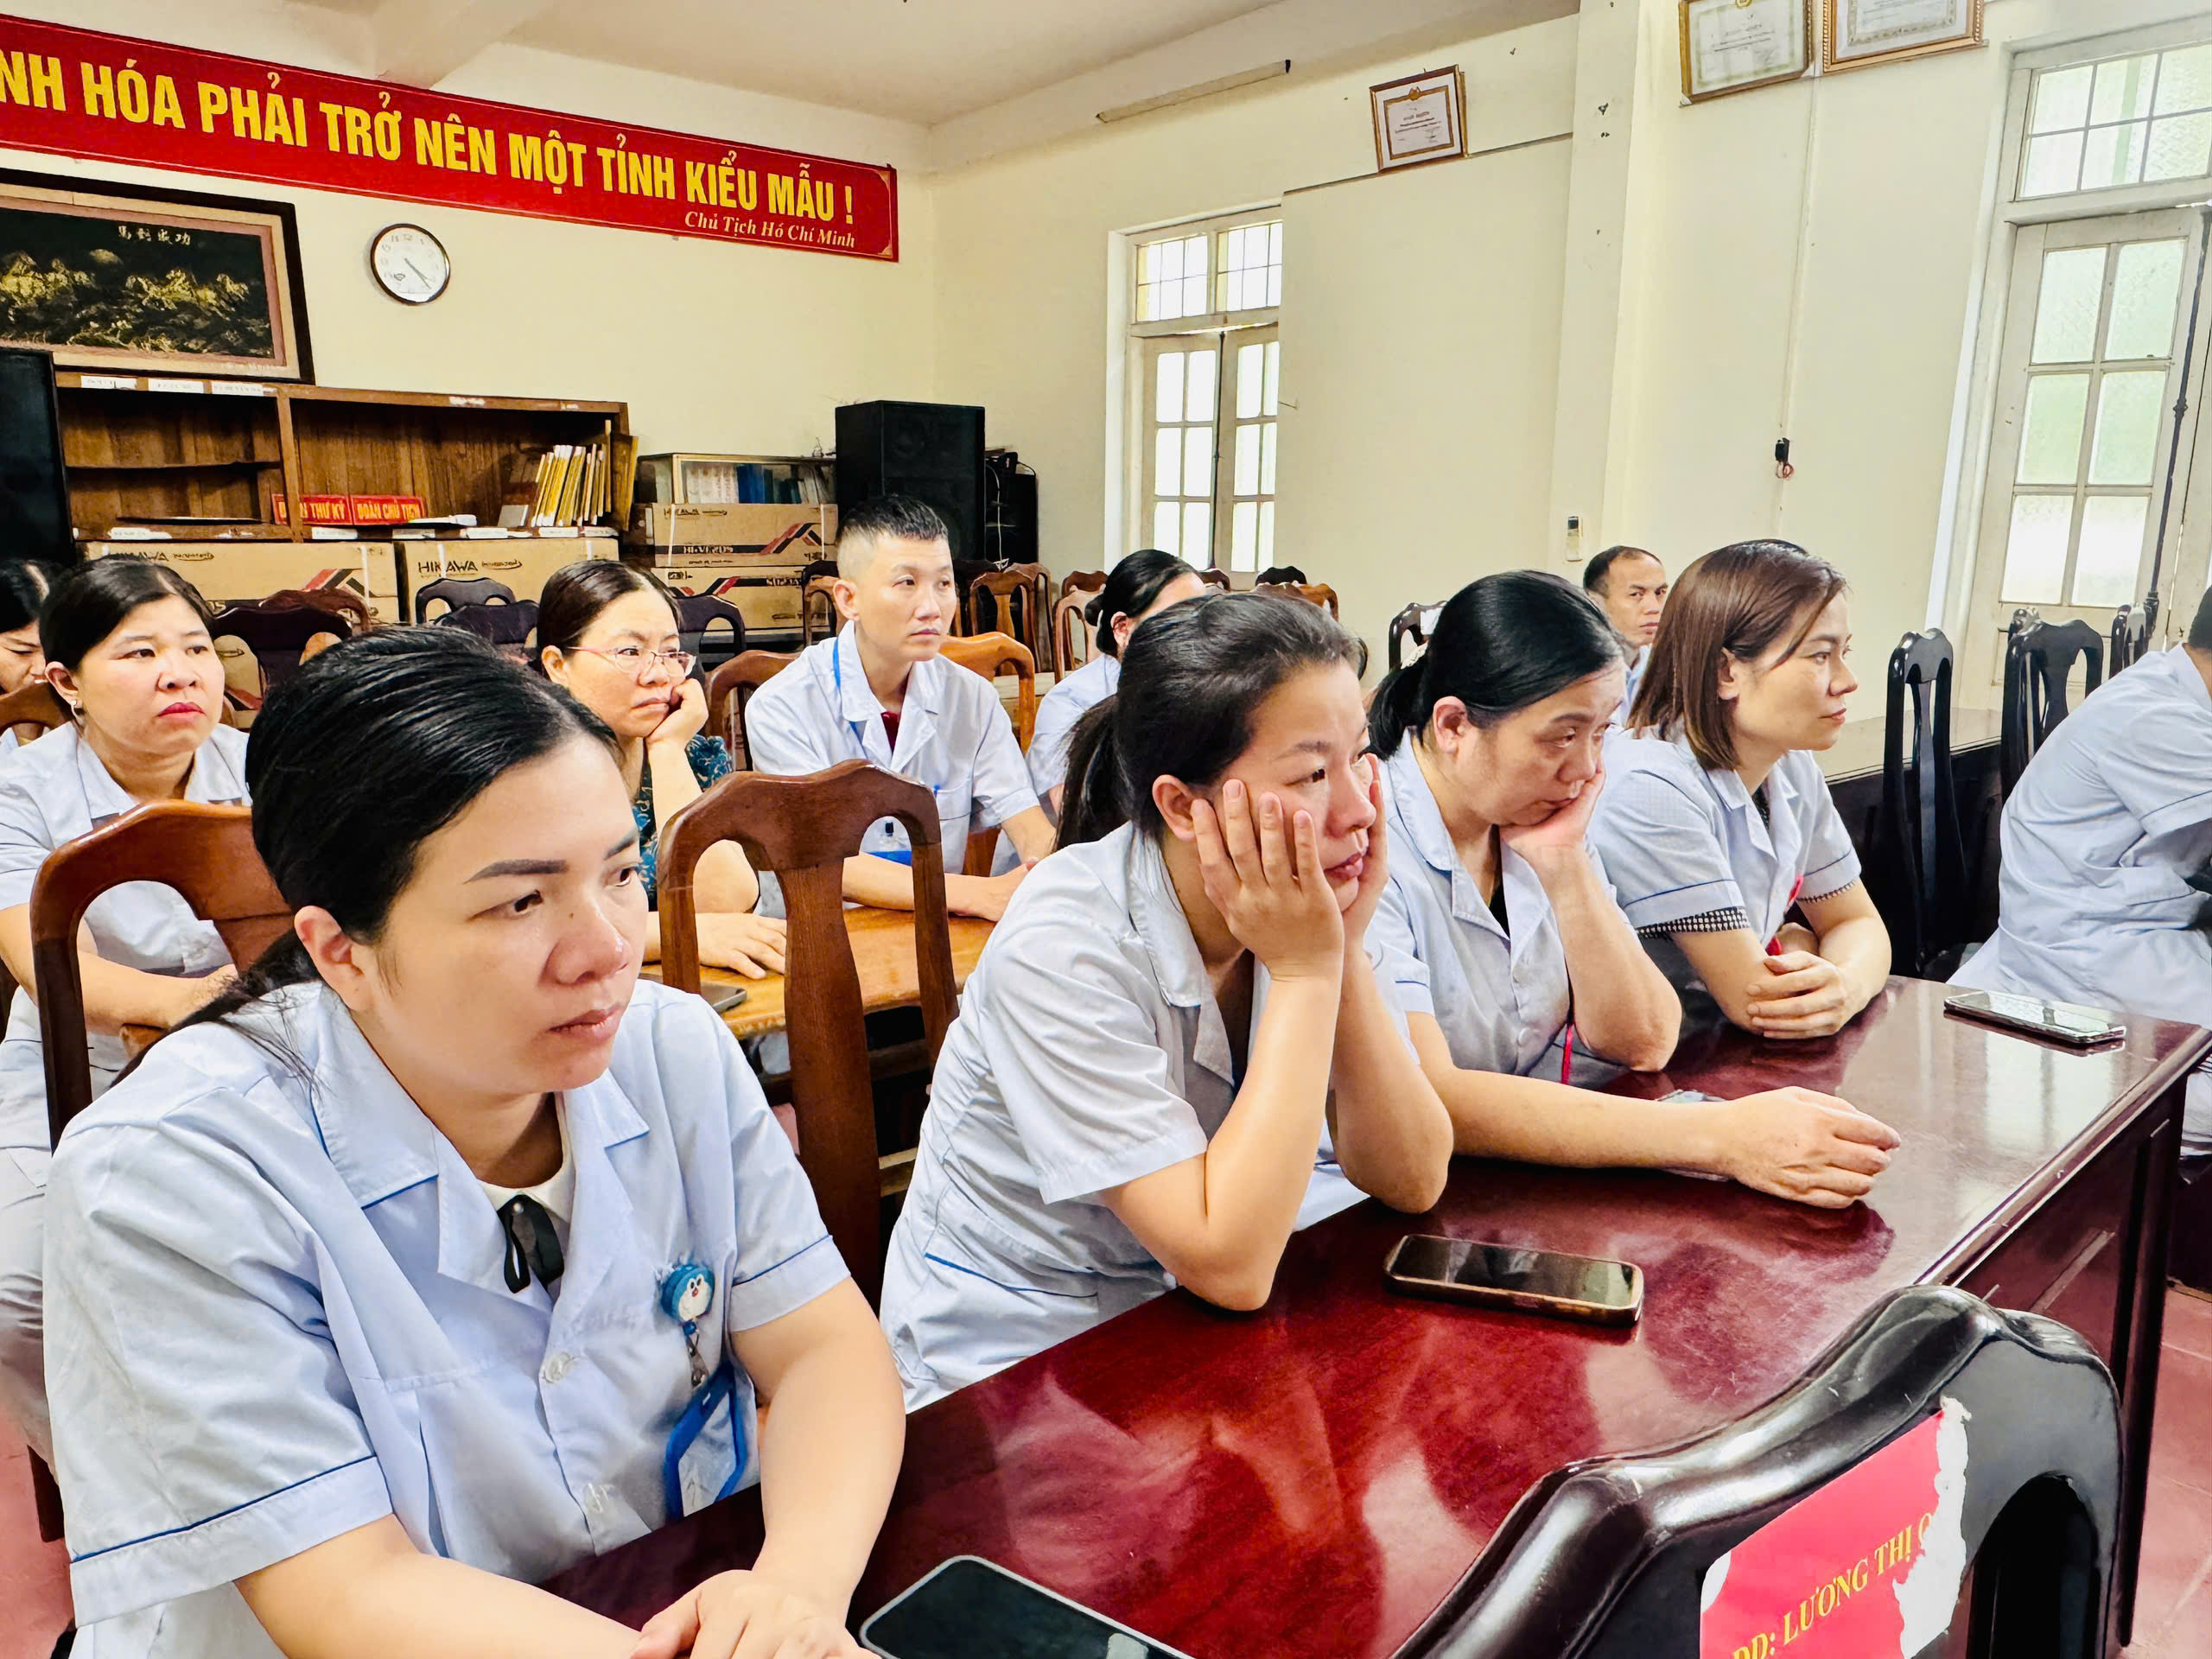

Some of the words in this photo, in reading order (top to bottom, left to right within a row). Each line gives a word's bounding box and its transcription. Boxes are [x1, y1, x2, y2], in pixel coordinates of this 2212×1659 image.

[80, 59, 186, 129] HÓA
[197, 72, 308, 147] PHẢI
[319, 91, 402, 161] TRỞ
[414, 113, 498, 175] NÊN
[508, 130, 587, 194] MỘT
[596, 133, 676, 200] TỈNH
[685, 150, 758, 211] KIỂU
[767, 162, 834, 221] MẪU
[844, 186, 854, 225] !
[684, 211, 719, 230] Chủ
[722, 216, 757, 237] Tịch
[787, 224, 815, 243] Chí
[817, 228, 855, 249] Minh
[1783, 1557, 1869, 1646] LƯƠNG
[1873, 1524, 1912, 1577] THỊ
